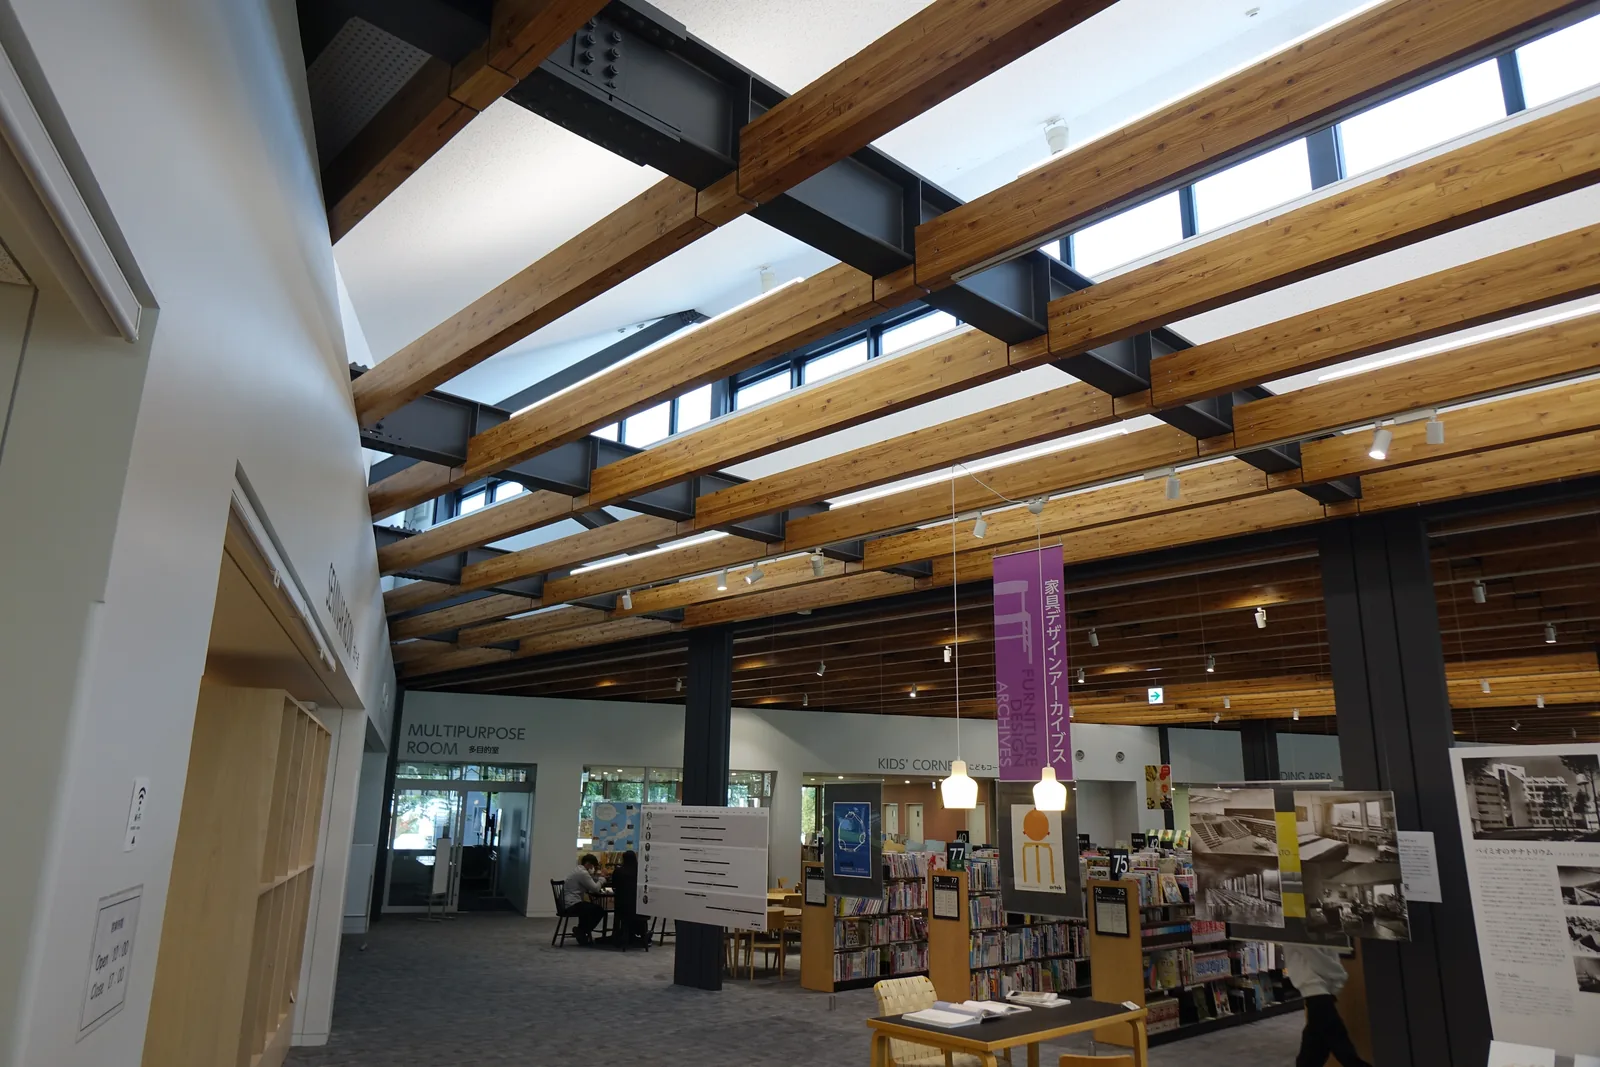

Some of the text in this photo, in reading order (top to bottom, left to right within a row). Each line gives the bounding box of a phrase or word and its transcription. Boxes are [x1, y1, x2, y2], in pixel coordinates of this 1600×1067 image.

[1044, 579, 1067, 763] 家具デザインアーカイブス
[997, 680, 1012, 767] ARCHIVES
[1021, 668, 1038, 767] FURNITURE
[408, 723, 526, 741] MULTIPURPOSE
[1010, 699, 1025, 767] DESIGN
[406, 741, 459, 755] ROOM
[468, 745, 500, 755] 多目的室
[877, 758, 953, 771] KIDS' CORNE
[968, 763, 999, 771] こどもコー
[1280, 771, 1305, 780] DING
[950, 847, 965, 860] 77
[1113, 855, 1128, 874] 75
